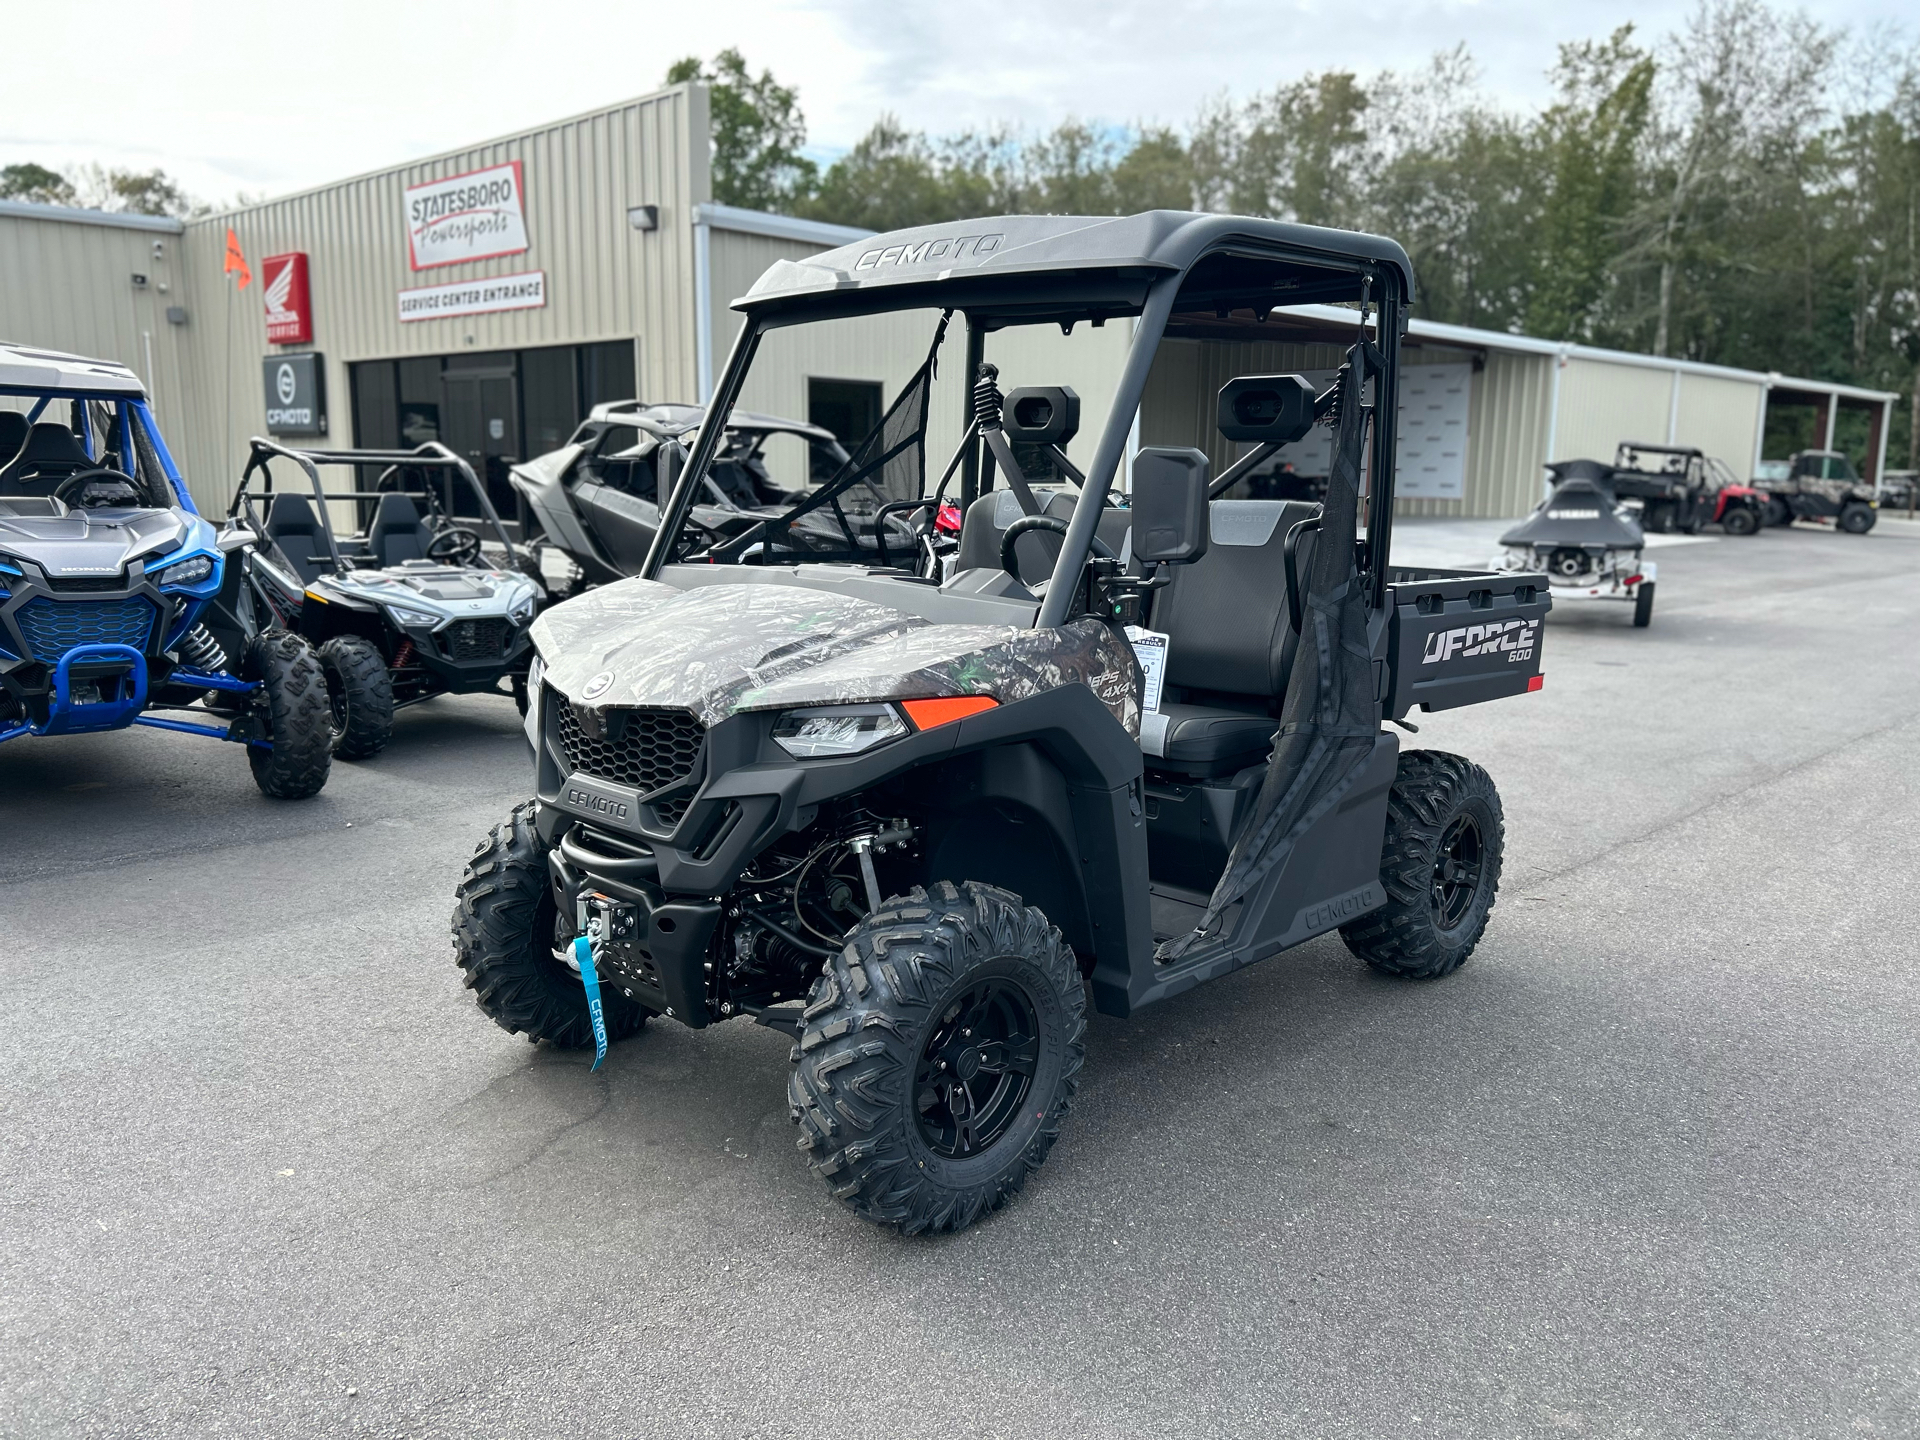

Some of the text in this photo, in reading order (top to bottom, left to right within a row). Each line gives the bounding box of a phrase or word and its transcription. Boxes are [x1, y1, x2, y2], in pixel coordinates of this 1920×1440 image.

[412, 178, 511, 223] STATESBORO
[420, 208, 508, 248] Powersports
[854, 233, 1006, 271] CFMOTO
[401, 282, 541, 312] SERVICE CENTER ENTRANCE
[267, 408, 311, 425] CFMOTO
[1221, 514, 1267, 523] CFMOTO
[1137, 639, 1162, 647] RESULT
[1422, 619, 1539, 664] UFORCE
[1508, 648, 1532, 663] 600
[1091, 671, 1121, 688] EPS
[1102, 682, 1130, 698] 4X4
[568, 788, 628, 820] CFMOTO
[1305, 887, 1373, 930] CFMOTO
[591, 998, 608, 1059] CFMOTO
